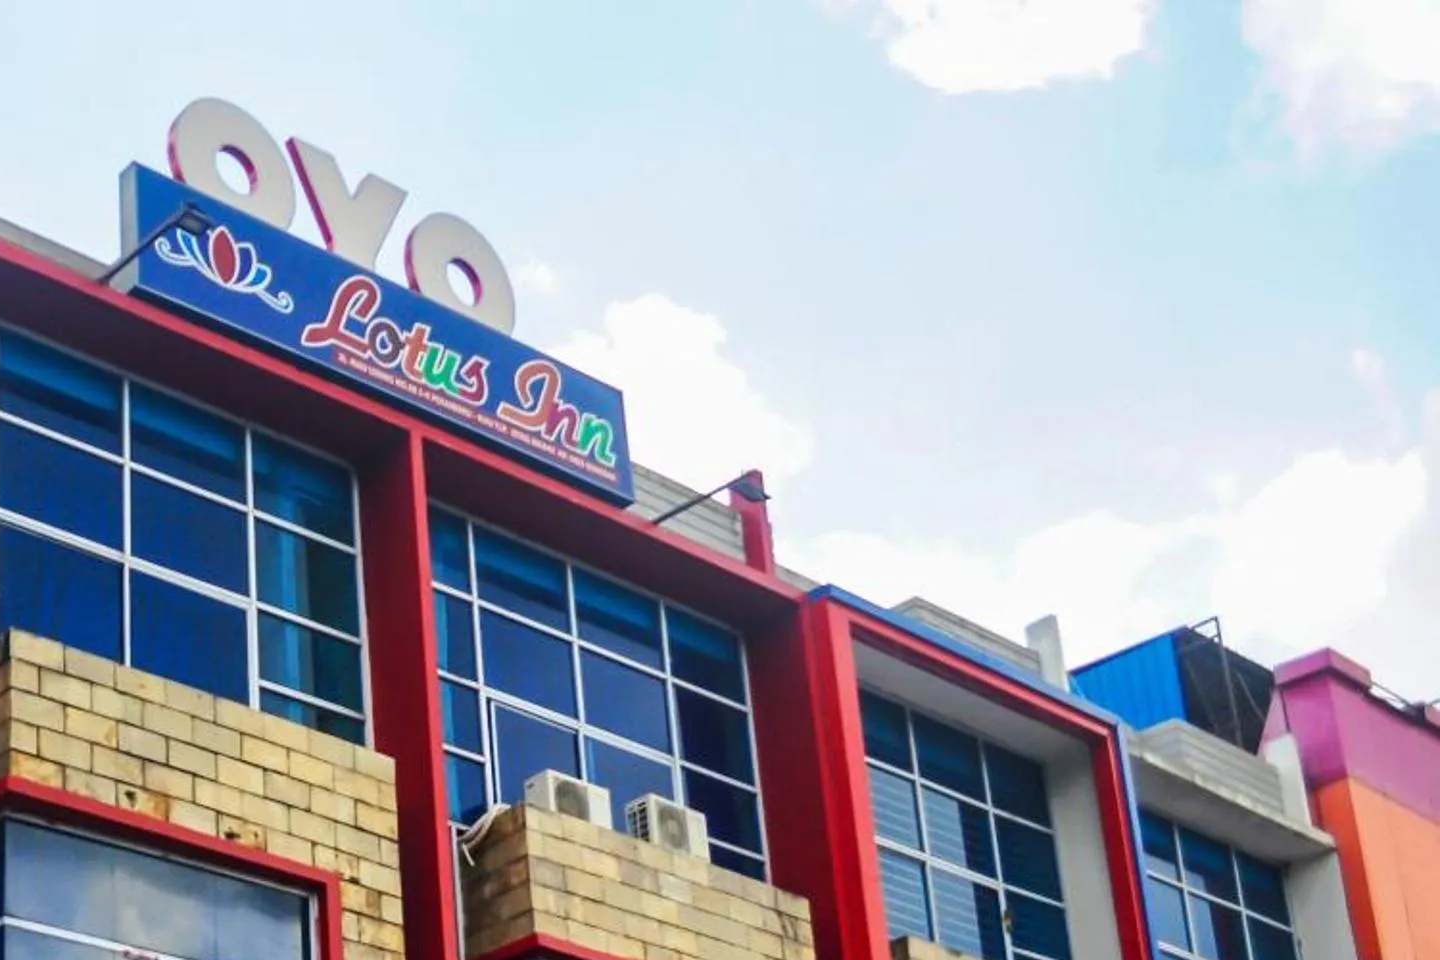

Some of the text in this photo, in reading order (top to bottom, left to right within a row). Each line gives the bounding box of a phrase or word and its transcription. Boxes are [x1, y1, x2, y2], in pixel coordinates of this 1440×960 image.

[166, 96, 516, 339] OYO
[300, 275, 490, 407] Lotus
[497, 359, 617, 468] Inn
